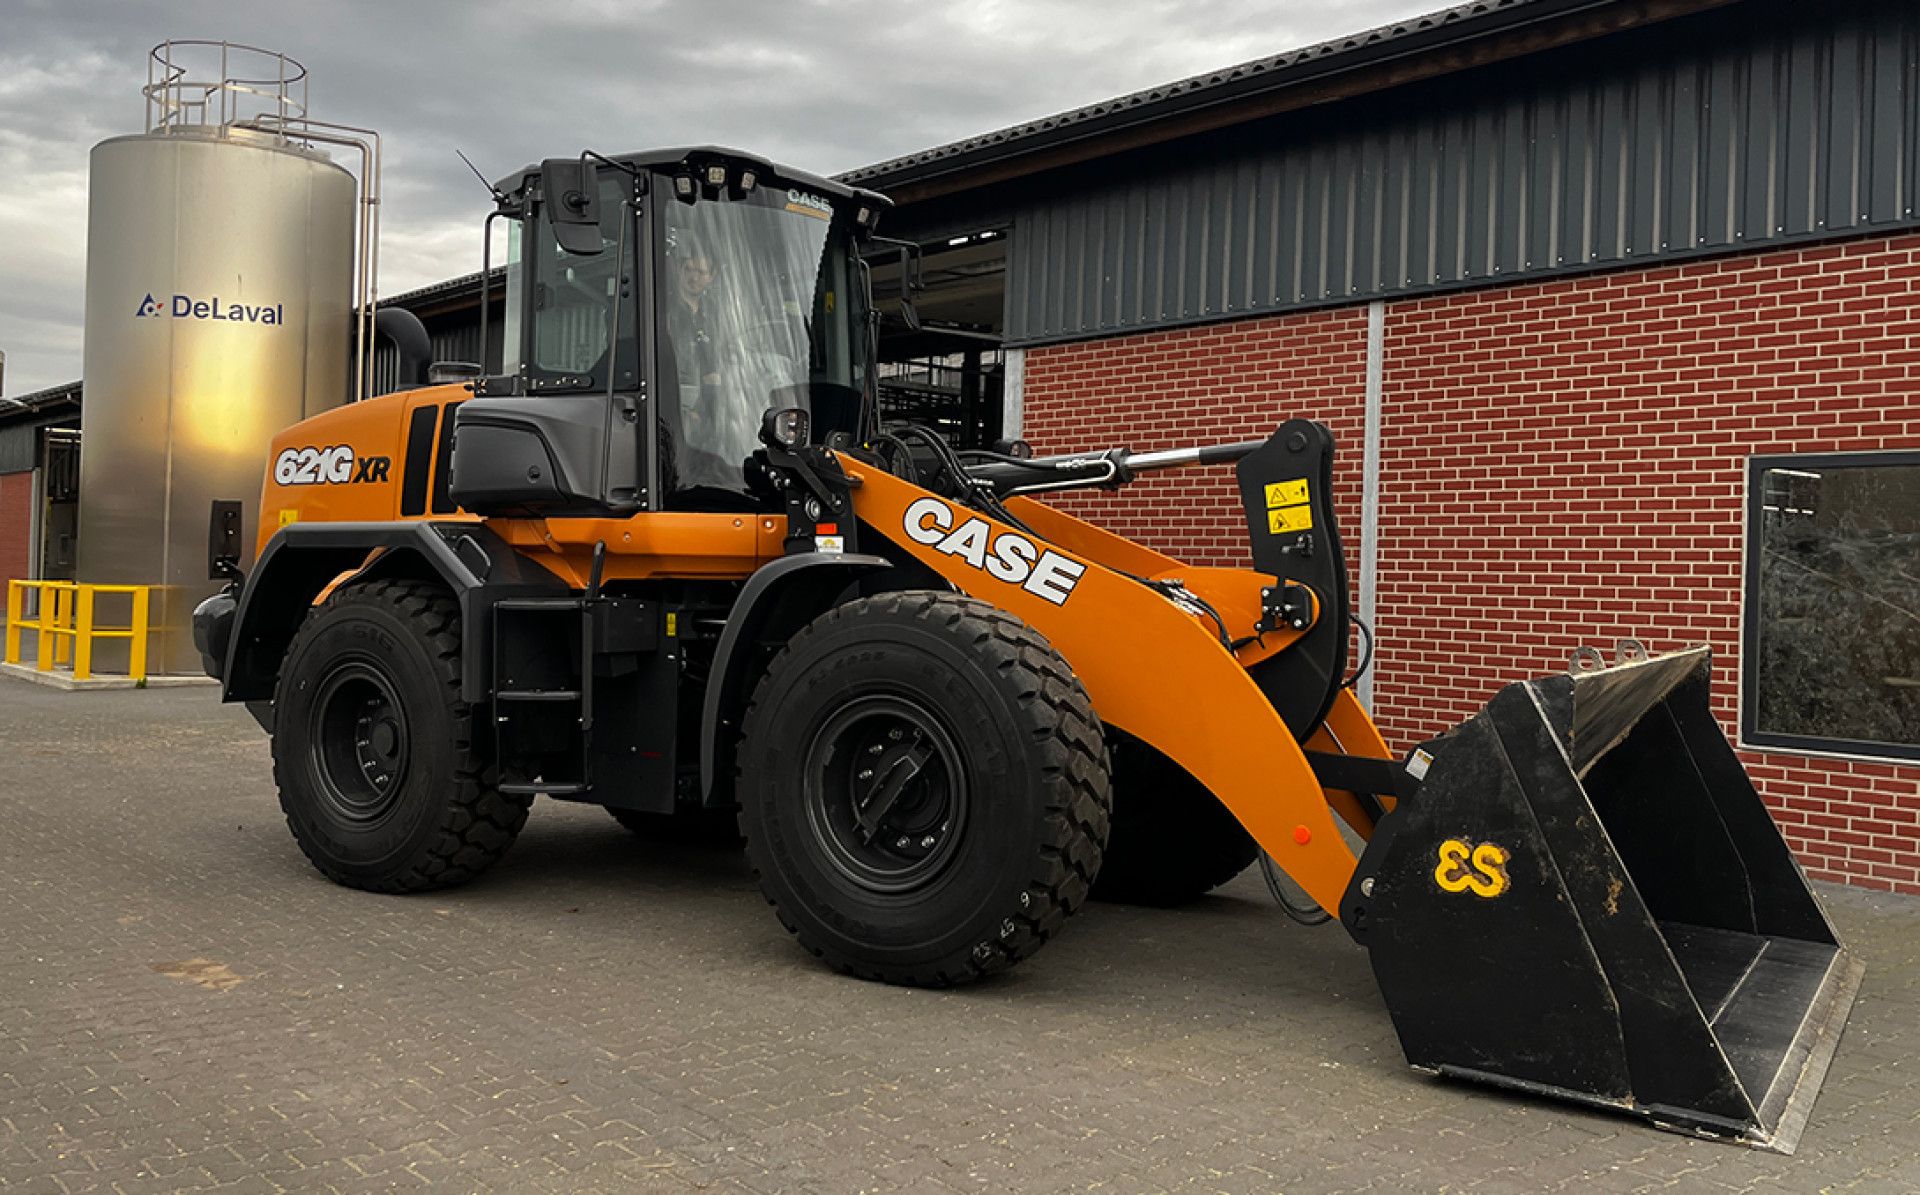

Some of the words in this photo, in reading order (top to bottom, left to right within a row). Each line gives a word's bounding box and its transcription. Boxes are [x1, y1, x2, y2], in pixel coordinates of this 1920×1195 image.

[787, 188, 830, 213] CASE
[172, 295, 283, 325] DeLaval
[275, 444, 354, 486] 621G
[353, 456, 391, 484] XR
[903, 497, 1088, 607] CASE
